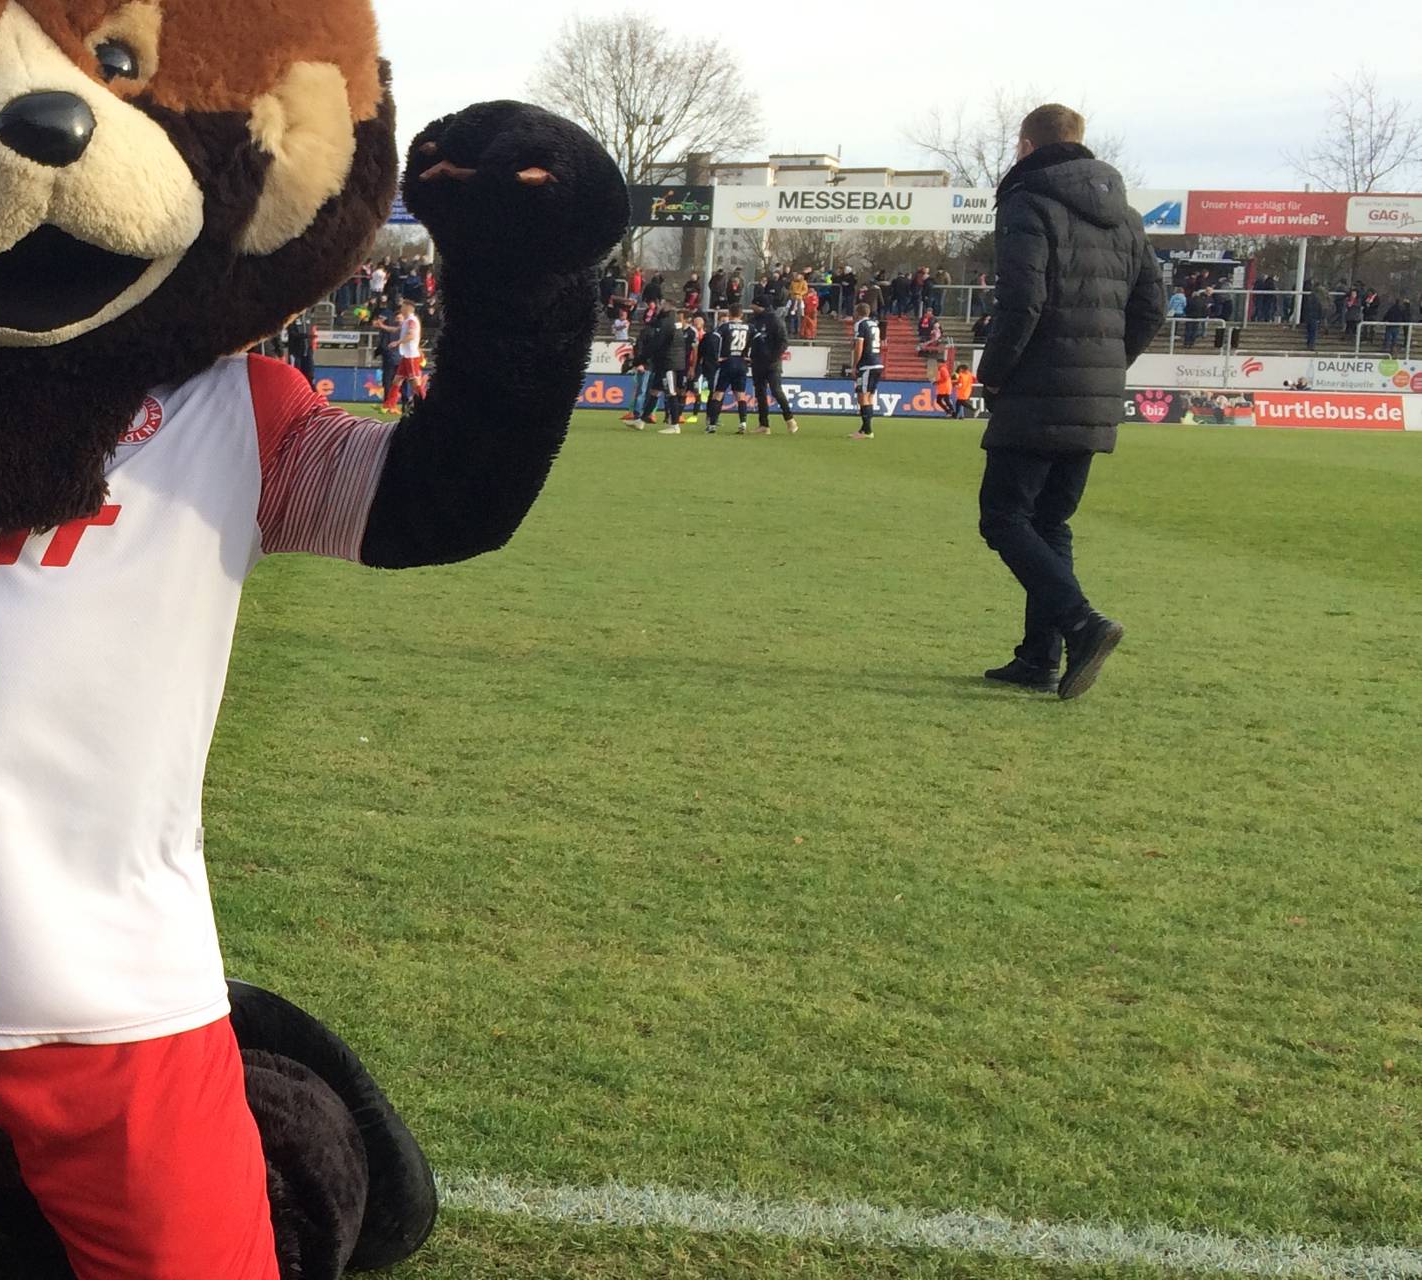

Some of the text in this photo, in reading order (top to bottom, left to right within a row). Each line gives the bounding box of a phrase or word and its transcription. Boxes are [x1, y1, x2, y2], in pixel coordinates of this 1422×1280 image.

[778, 191, 913, 211] MESSEBAU
[1201, 201, 1302, 212] Unser Herz schlägt für
[776, 214, 859, 224] www.genial5.de
[1269, 216, 1285, 225] un
[1368, 209, 1399, 221] GAG
[730, 330, 747, 350] 28
[1317, 361, 1374, 373] DAUNER
[1254, 400, 1402, 422] Turtlebus.de
